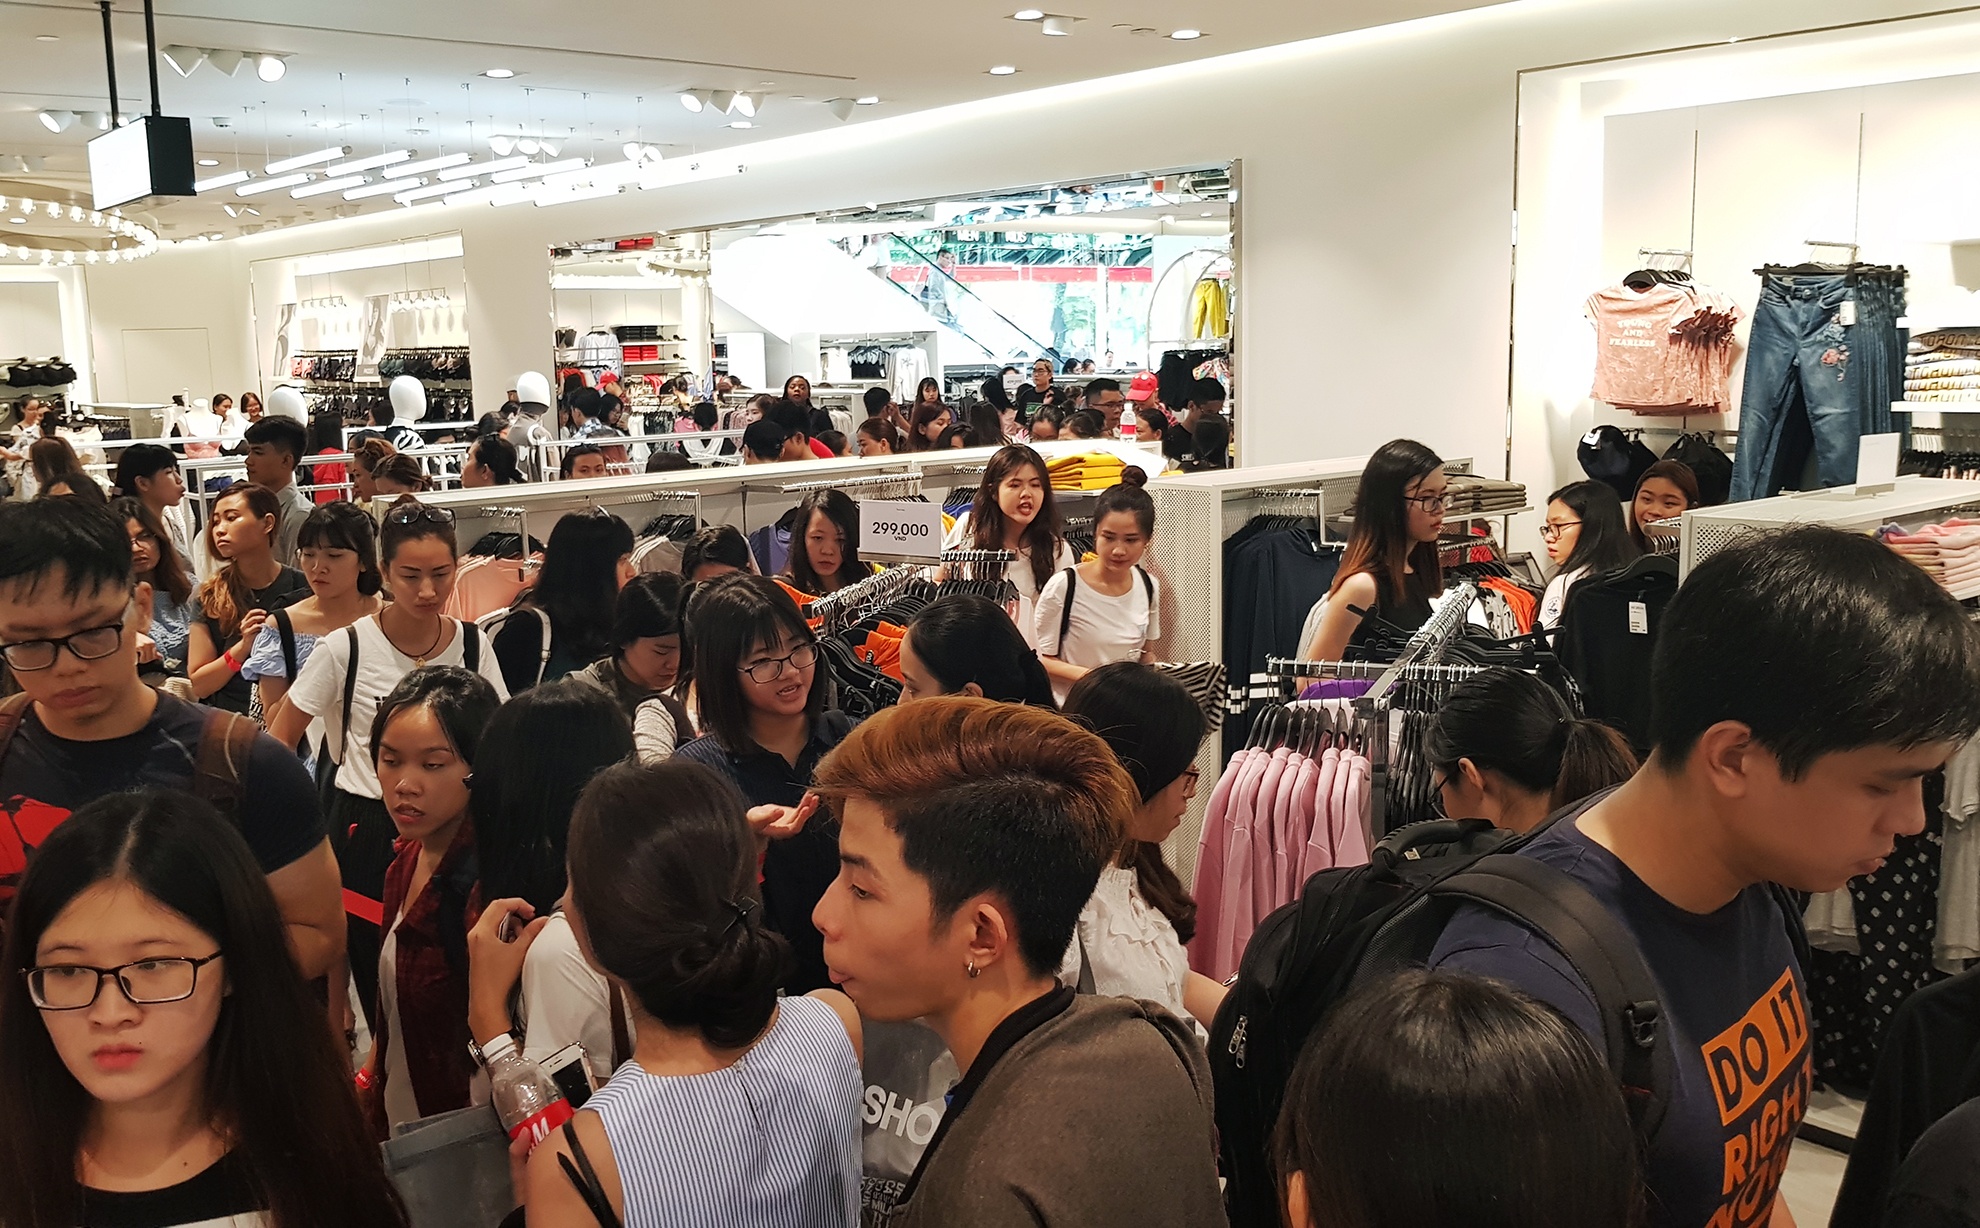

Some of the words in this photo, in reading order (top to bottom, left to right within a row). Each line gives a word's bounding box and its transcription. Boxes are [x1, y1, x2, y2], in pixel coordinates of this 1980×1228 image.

[1616, 319, 1653, 329] YOUNG
[1622, 329, 1644, 337] AND
[1608, 338, 1656, 347] FEARLESS
[872, 521, 930, 537] 299.000
[1708, 1022, 1769, 1113] DO
[1769, 979, 1802, 1055] IT
[1722, 1053, 1813, 1195] RIGHT
